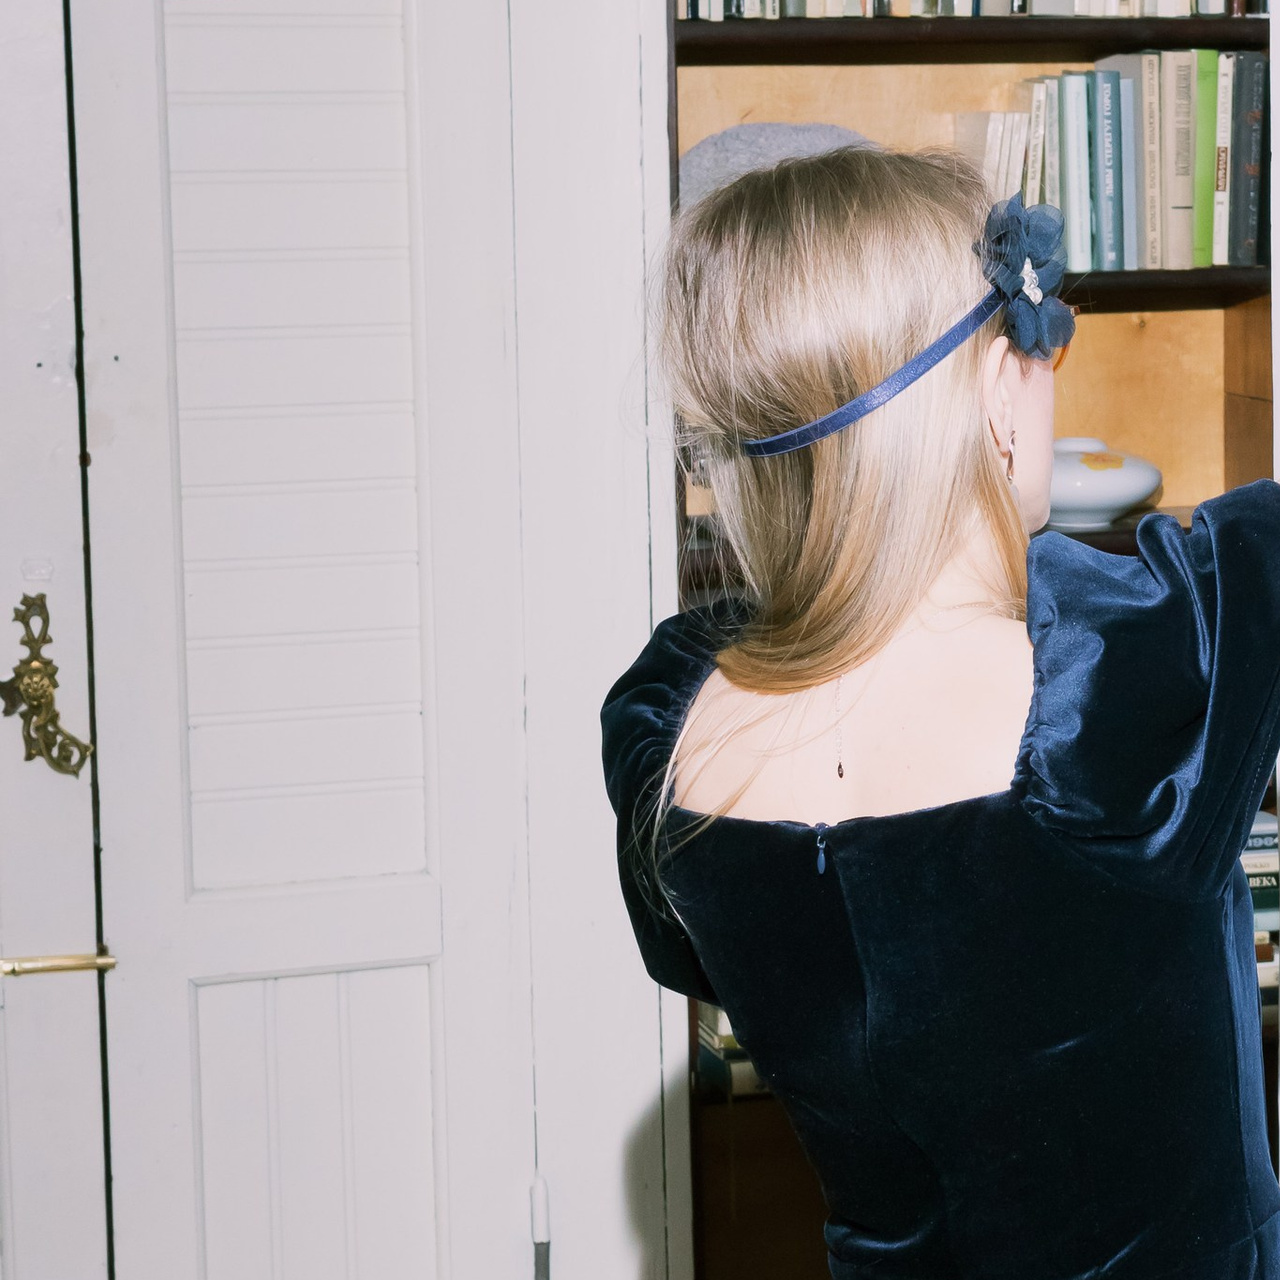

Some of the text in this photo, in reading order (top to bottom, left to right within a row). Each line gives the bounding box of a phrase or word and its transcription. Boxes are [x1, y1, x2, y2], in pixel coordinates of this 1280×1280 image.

[1103, 83, 1112, 116] ГОРОД
[1104, 119, 1113, 166] СТЕРЕГУТ
[1105, 168, 1114, 197] ЛЬВЫ
[1249, 876, 1278, 887] ВЕКА
